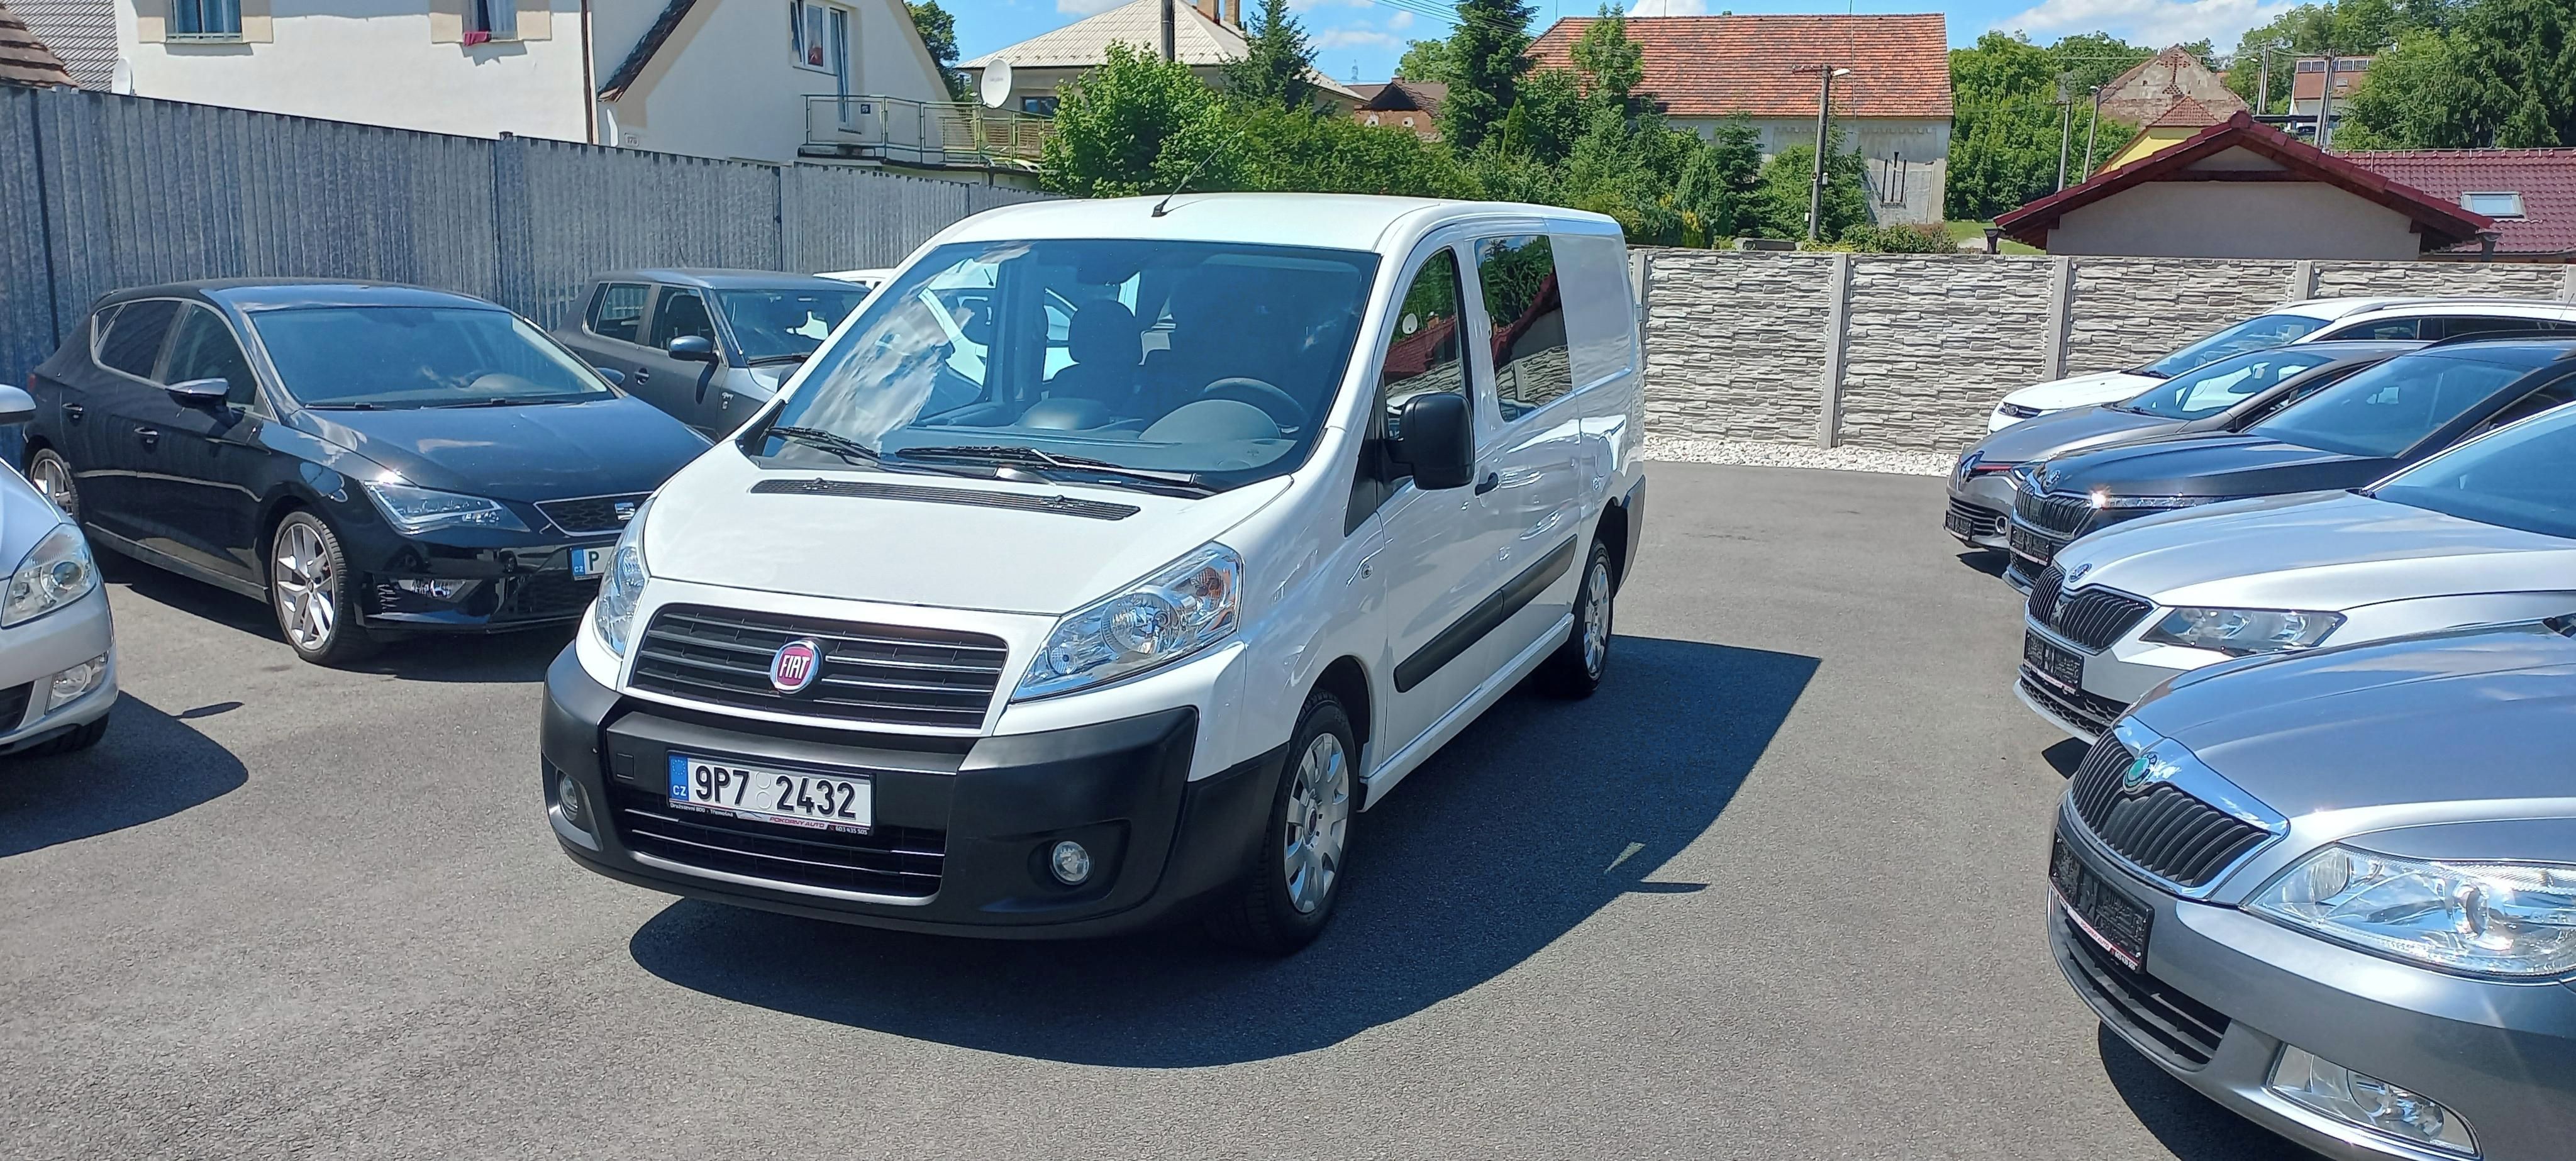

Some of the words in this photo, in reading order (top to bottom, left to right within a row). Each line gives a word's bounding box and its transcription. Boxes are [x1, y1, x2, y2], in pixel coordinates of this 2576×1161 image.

[588, 550, 599, 571] P
[779, 654, 811, 679] FIAT
[672, 785, 687, 797] CZ
[696, 765, 750, 806] 9P7
[775, 775, 856, 818] 2432
